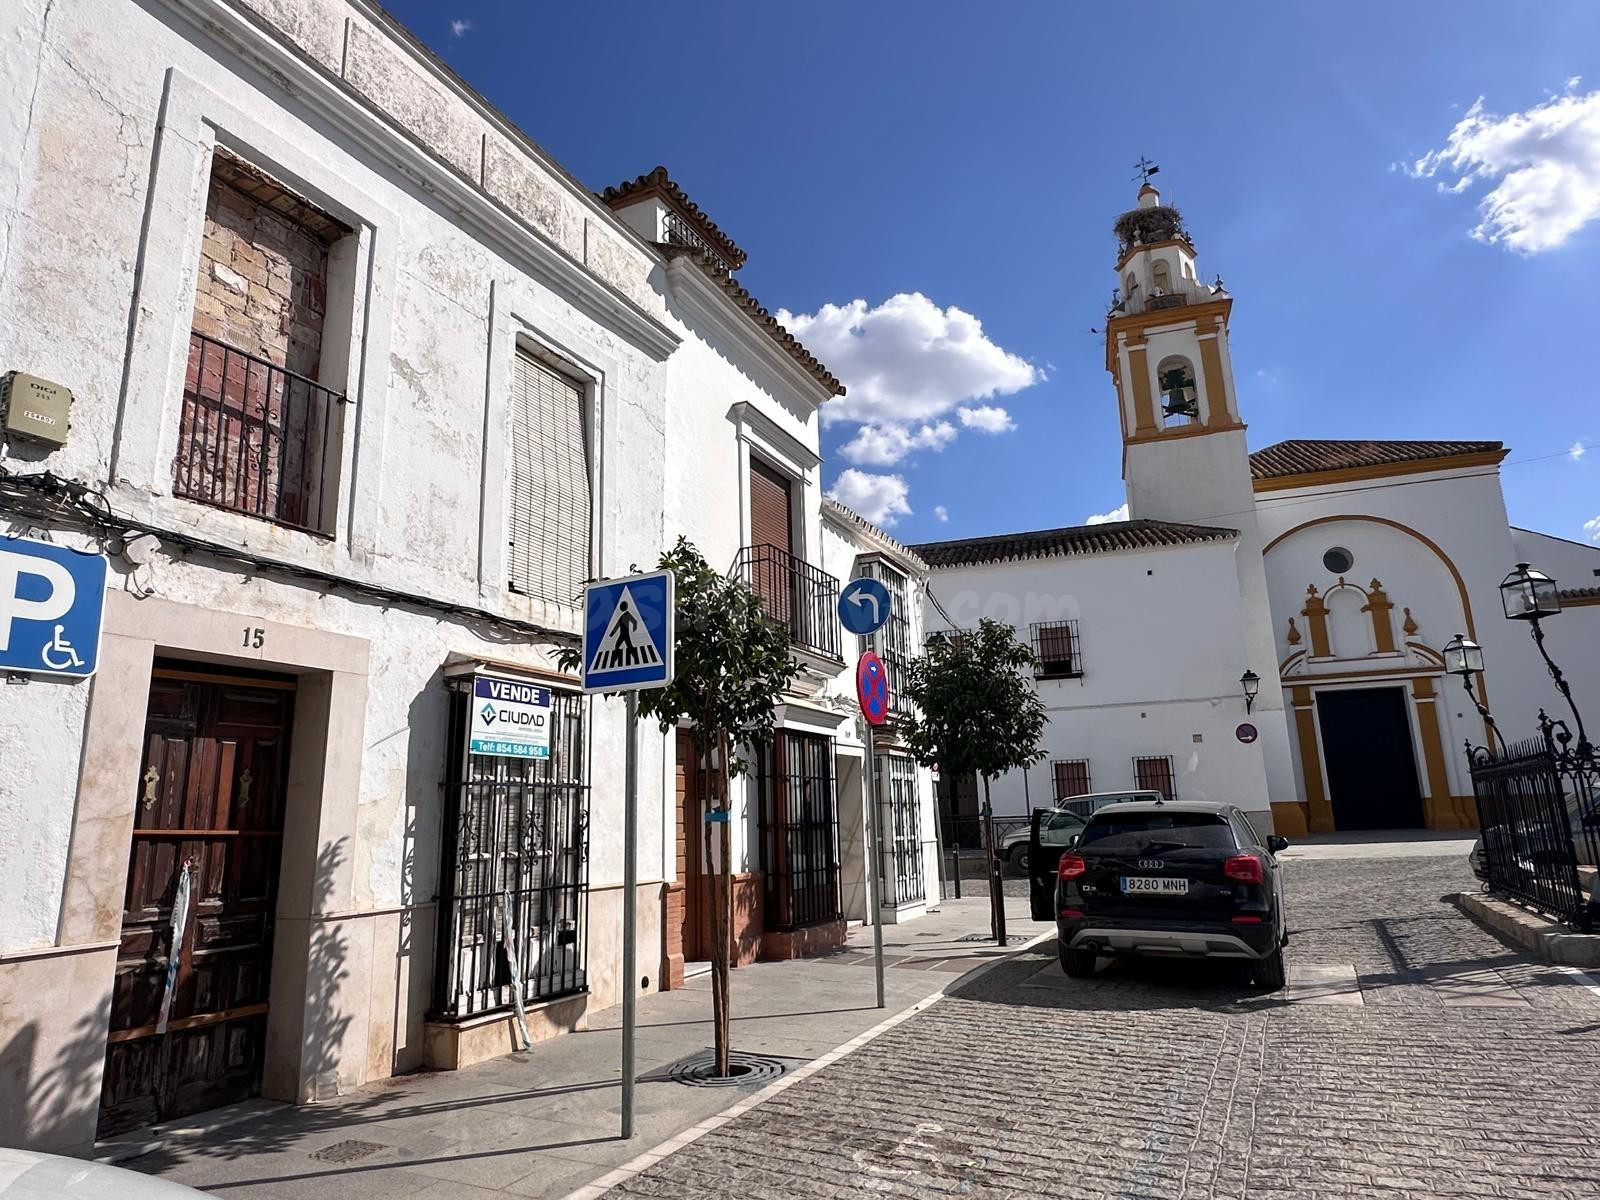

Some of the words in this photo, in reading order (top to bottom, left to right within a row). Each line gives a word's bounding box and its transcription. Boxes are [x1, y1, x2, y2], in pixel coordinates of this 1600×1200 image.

[30, 383, 57, 395] DIGI
[0, 551, 76, 651] P
[243, 627, 265, 649] 15
[489, 682, 540, 703] VENDE
[499, 710, 544, 726] CIUDAD
[479, 741, 495, 752] Telf:
[496, 743, 512, 753] 854
[512, 745, 527, 755] 584
[1129, 879, 1159, 890] 8280
[1163, 880, 1187, 891] MNH
